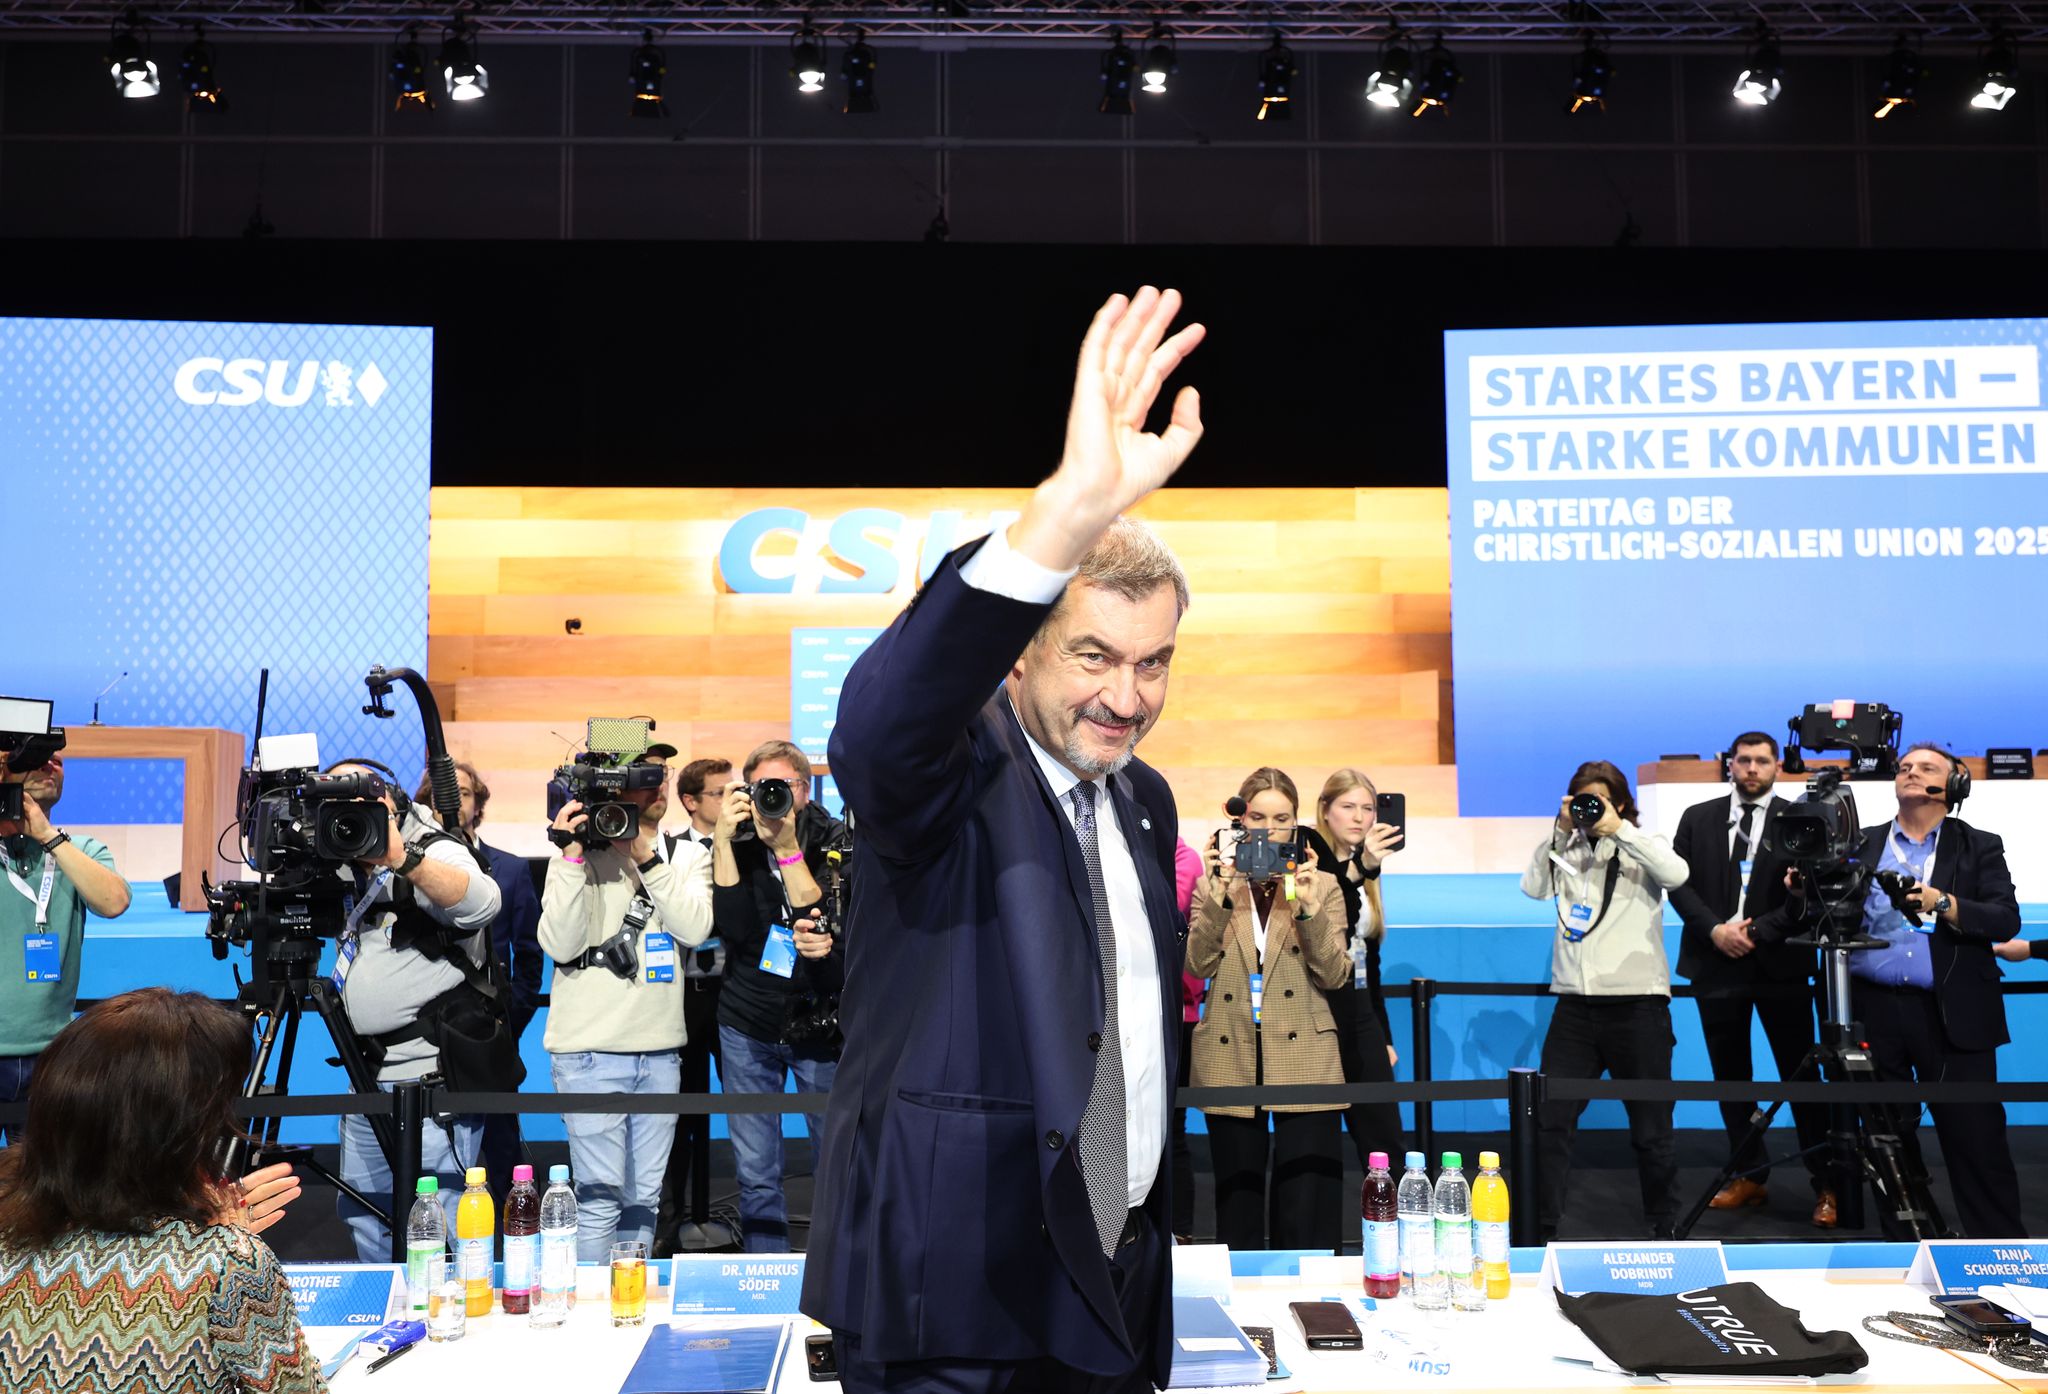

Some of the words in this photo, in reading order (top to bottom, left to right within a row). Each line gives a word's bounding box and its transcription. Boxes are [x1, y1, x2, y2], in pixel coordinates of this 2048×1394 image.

[174, 357, 320, 407] CSU
[1487, 364, 1716, 406] STARKES
[1741, 359, 1956, 401] BAYERN
[1488, 430, 1688, 471] STARKE
[1709, 424, 2035, 468] KOMMUNEN
[1473, 497, 1655, 527] PARTEITAG
[1668, 496, 1734, 525] DER
[1474, 529, 1842, 561] CHRISTLICH-SOZIALEN
[1855, 528, 1963, 557] UNION
[1603, 1252, 1675, 1264] ALEXANDER
[1992, 1249, 2032, 1262] TANJA
[722, 1264, 742, 1276] DR.
[745, 1264, 798, 1276] MARKUS
[1610, 1268, 1673, 1280] DOBRINDT
[1964, 1264, 2048, 1275] SCHORER-DRE
[738, 1278, 780, 1291] SÖDER
[347, 1314, 371, 1323] CSU
[1421, 1360, 1450, 1375] CSU
